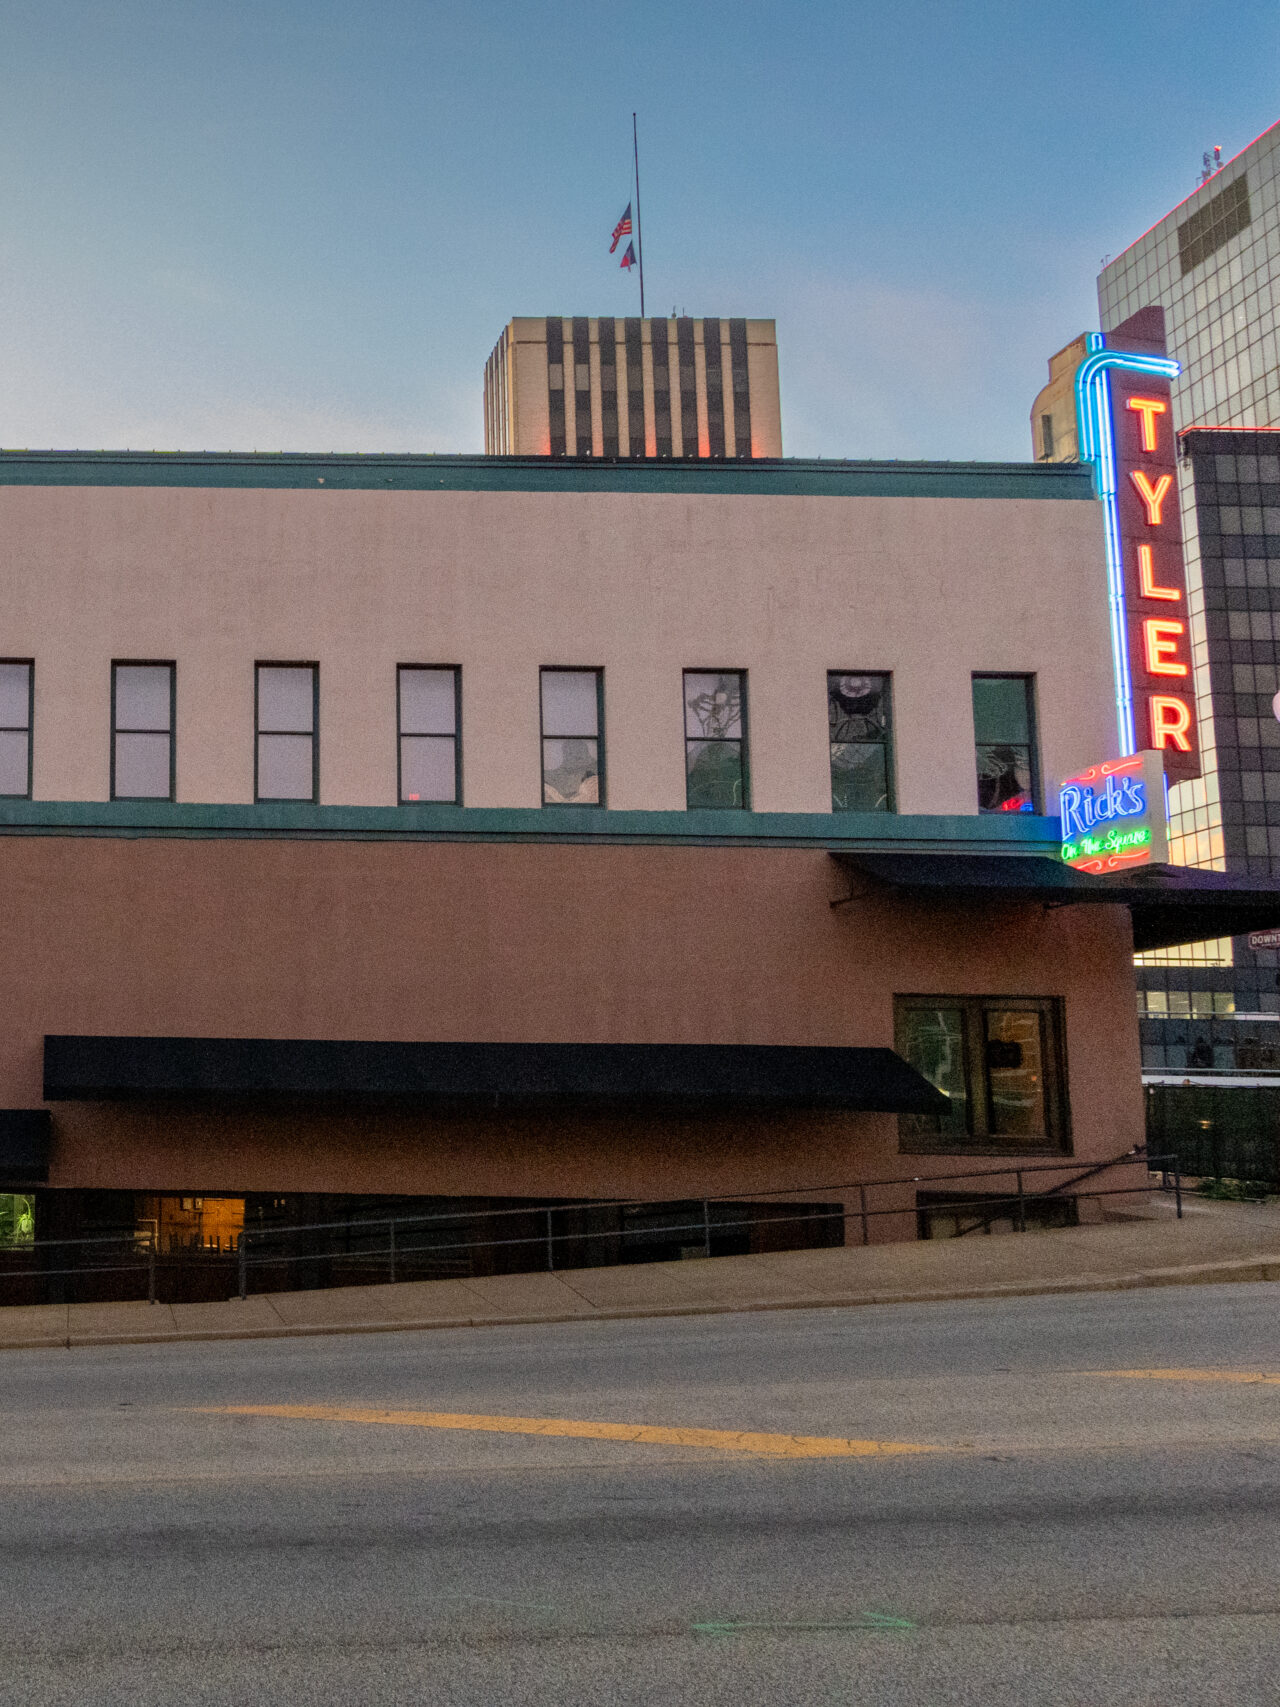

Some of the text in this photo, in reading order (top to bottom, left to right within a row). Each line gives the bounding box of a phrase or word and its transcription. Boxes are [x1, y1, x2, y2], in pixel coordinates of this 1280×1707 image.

[1125, 396, 1193, 753] TYLER
[1059, 775, 1144, 841] Rick's
[1061, 843, 1078, 860] On
[1105, 829, 1147, 854] Square
